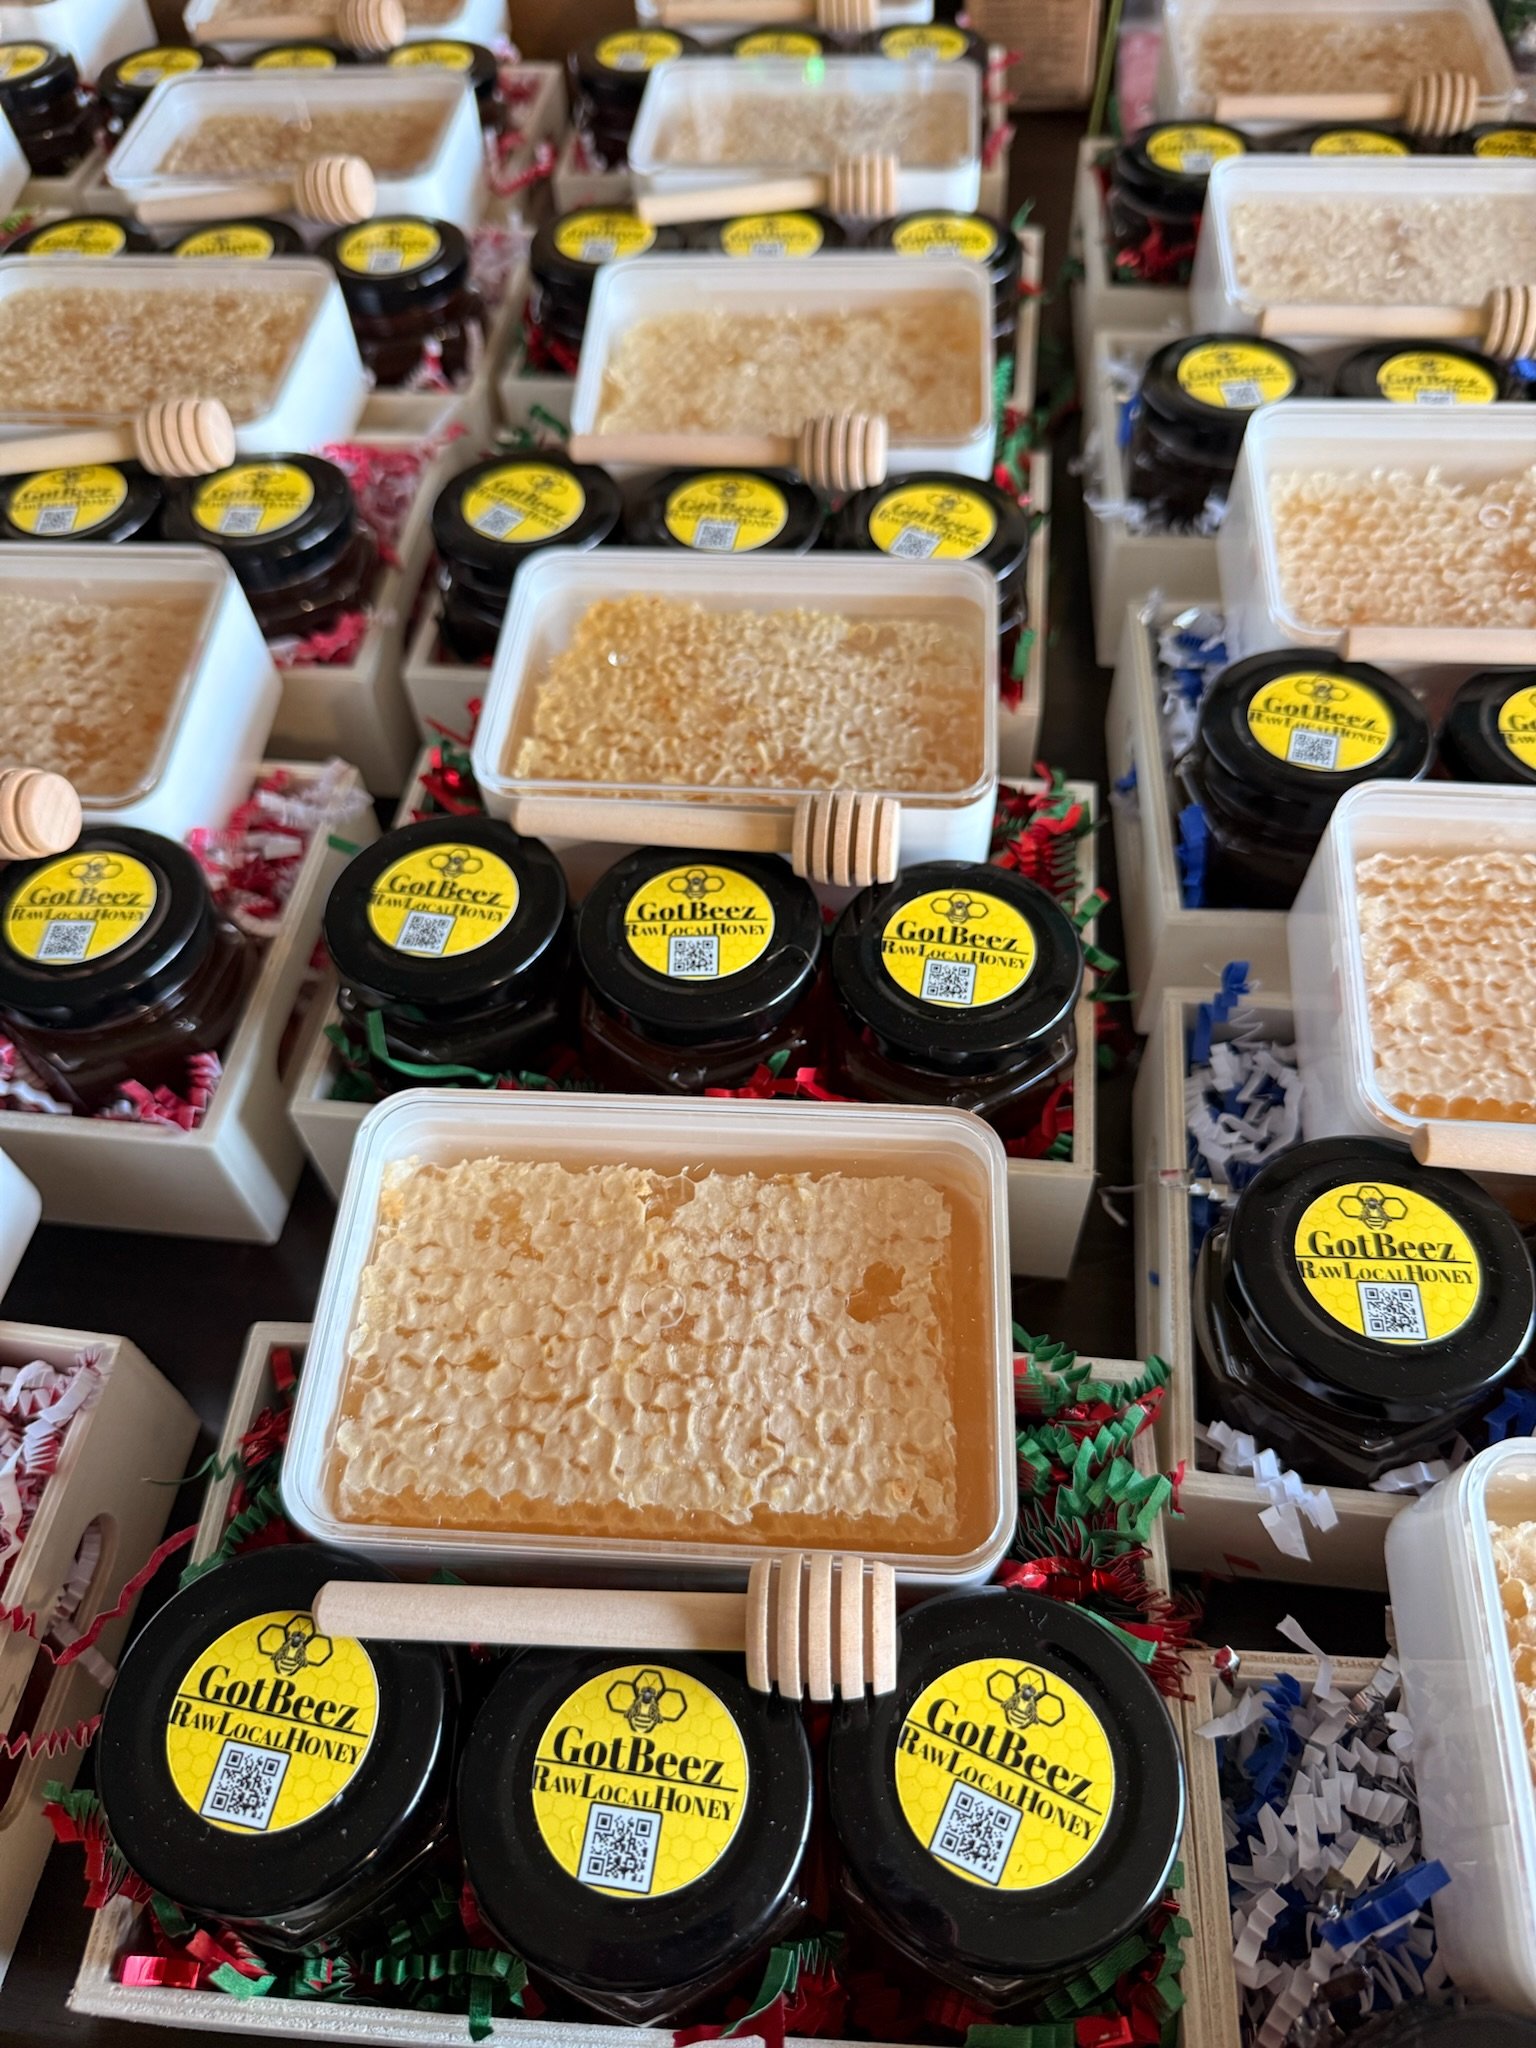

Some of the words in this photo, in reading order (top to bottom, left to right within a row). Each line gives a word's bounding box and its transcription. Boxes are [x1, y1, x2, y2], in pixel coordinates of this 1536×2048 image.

[1264, 698, 1377, 730] GotBeez
[30, 887, 144, 906] GotBeez
[389, 874, 503, 905] GotBeez
[637, 902, 757, 921] GotBeez
[896, 920, 1019, 952] GotBeez
[1308, 1230, 1456, 1260] GotBeez
[199, 1664, 360, 1731] GotBeez
[553, 1725, 725, 1786] GotBeez
[927, 1698, 1096, 1804] GotBeez
